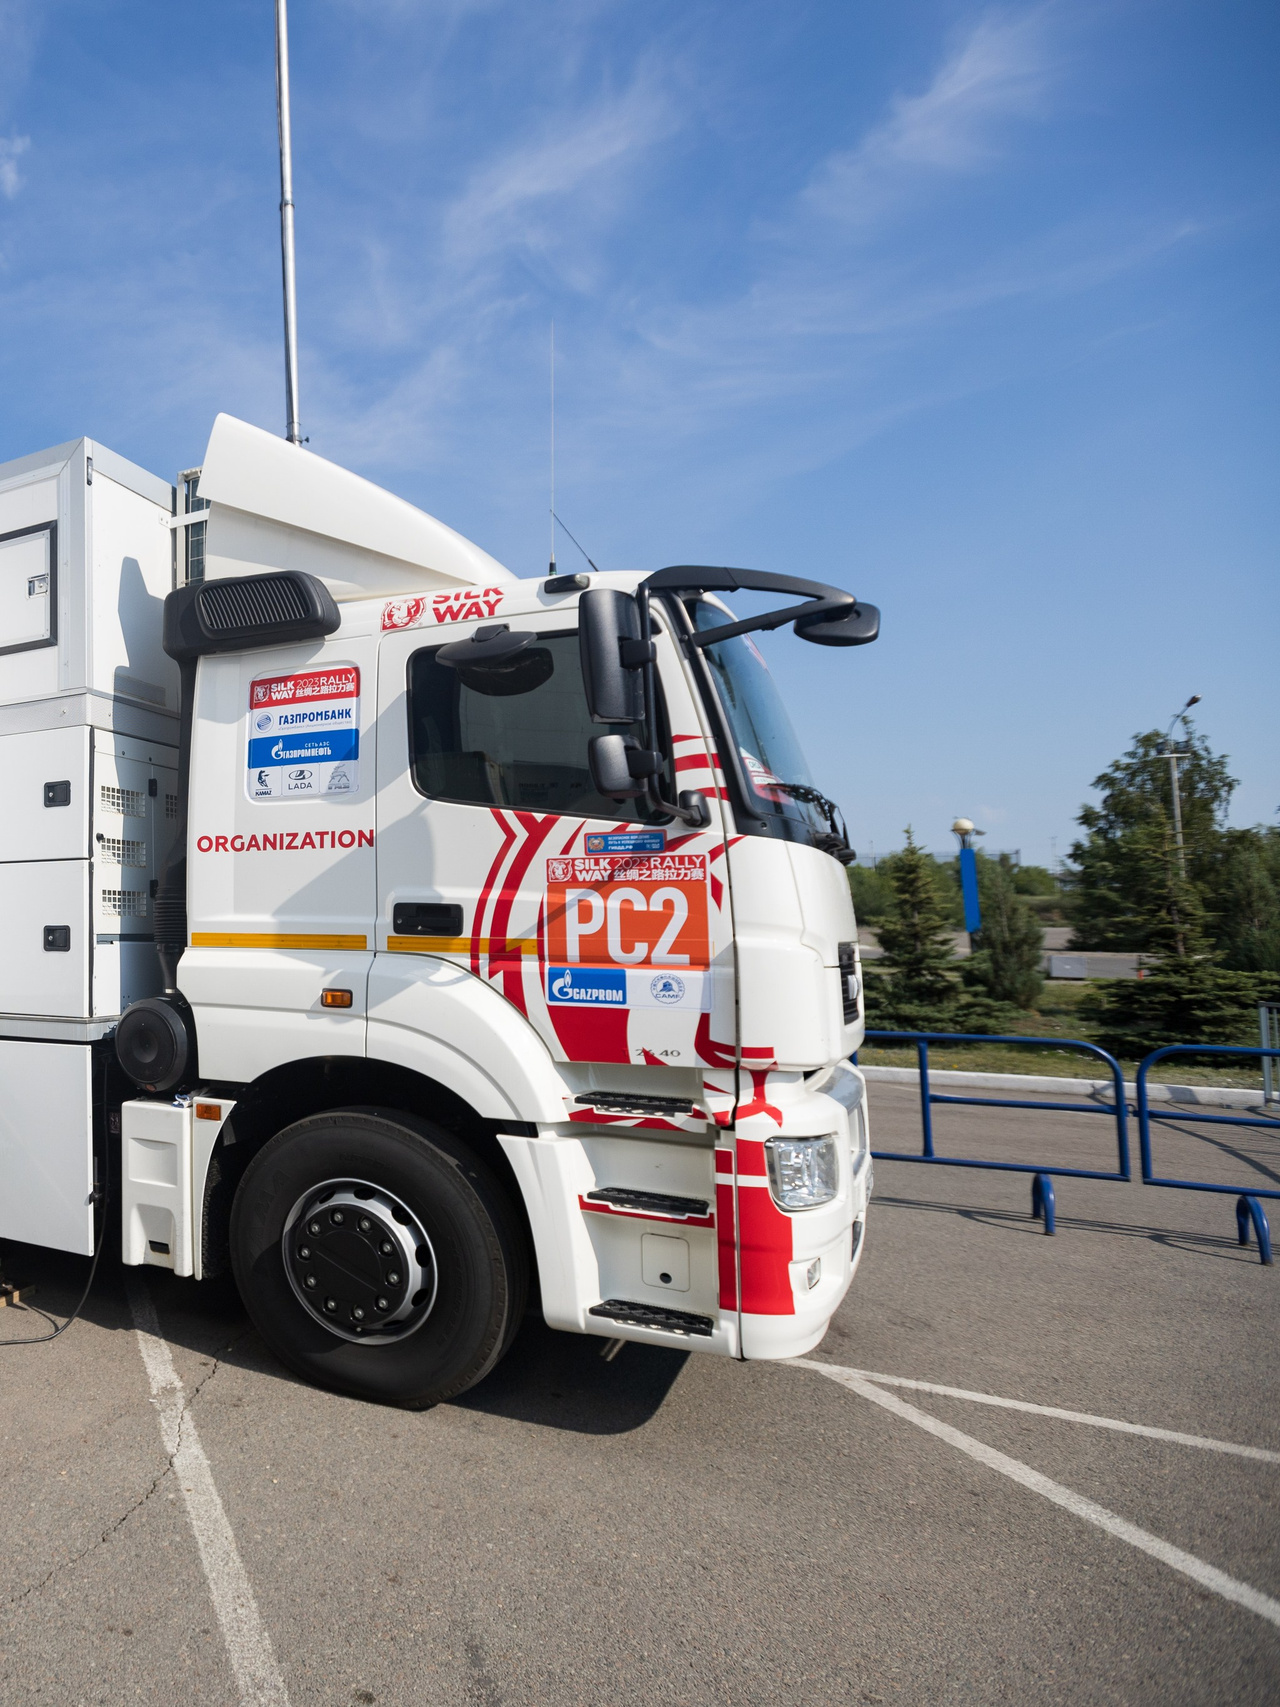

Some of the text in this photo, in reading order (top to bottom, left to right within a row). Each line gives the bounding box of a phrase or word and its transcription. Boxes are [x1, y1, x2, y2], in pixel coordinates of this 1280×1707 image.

[432, 596, 505, 624] WAY
[271, 681, 295, 692] SILK
[271, 690, 294, 701] WAY
[278, 708, 352, 726] ГАЗПРОМБАНК
[282, 747, 332, 759] ГАЗПРОМНЕФТЬ
[288, 782, 313, 790] LADA
[196, 829, 375, 853] ORGANIZATION
[574, 858, 611, 870] SILK
[575, 868, 705, 882] WAY 丝绸之路拉力赛
[565, 886, 691, 966] PC2
[573, 988, 623, 1002] GAZPROM
